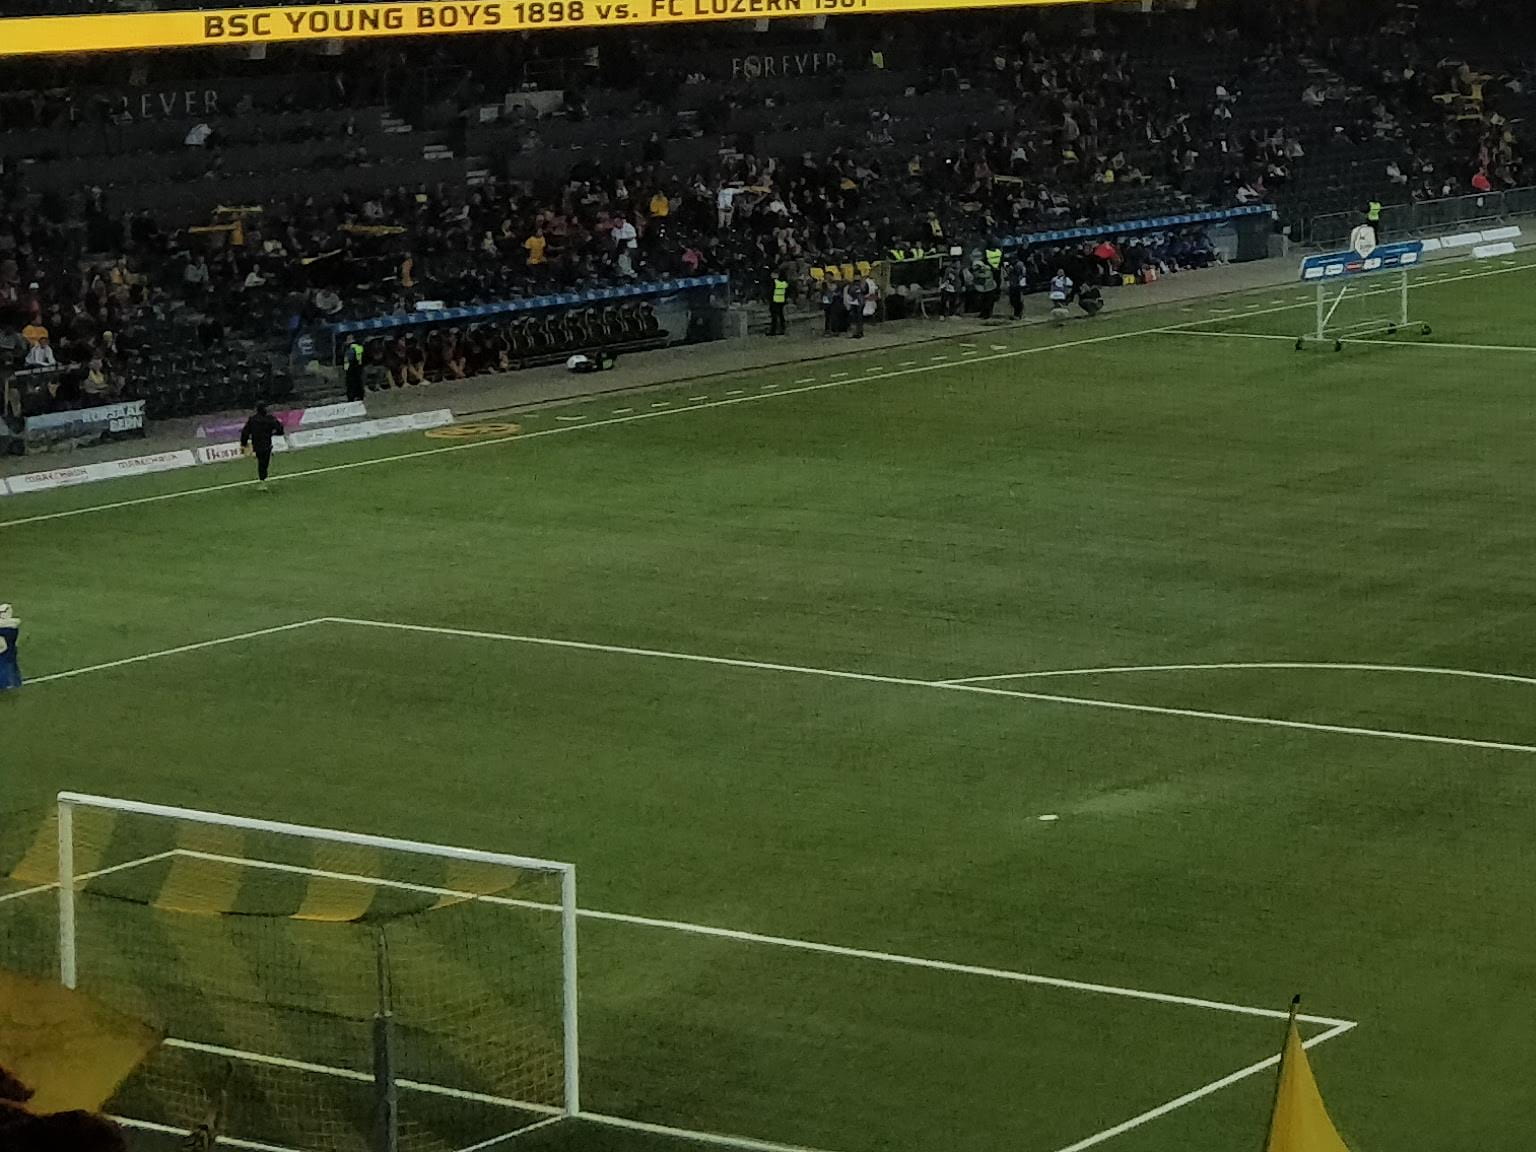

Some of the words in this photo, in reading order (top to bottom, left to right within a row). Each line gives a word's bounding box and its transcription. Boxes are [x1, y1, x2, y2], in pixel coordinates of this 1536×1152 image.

[203, 11, 271, 39] BSC
[286, 6, 404, 35] YOUNG
[416, 3, 502, 28] BOYS
[514, 0, 585, 24] 1898
[597, 2, 639, 20] vs.
